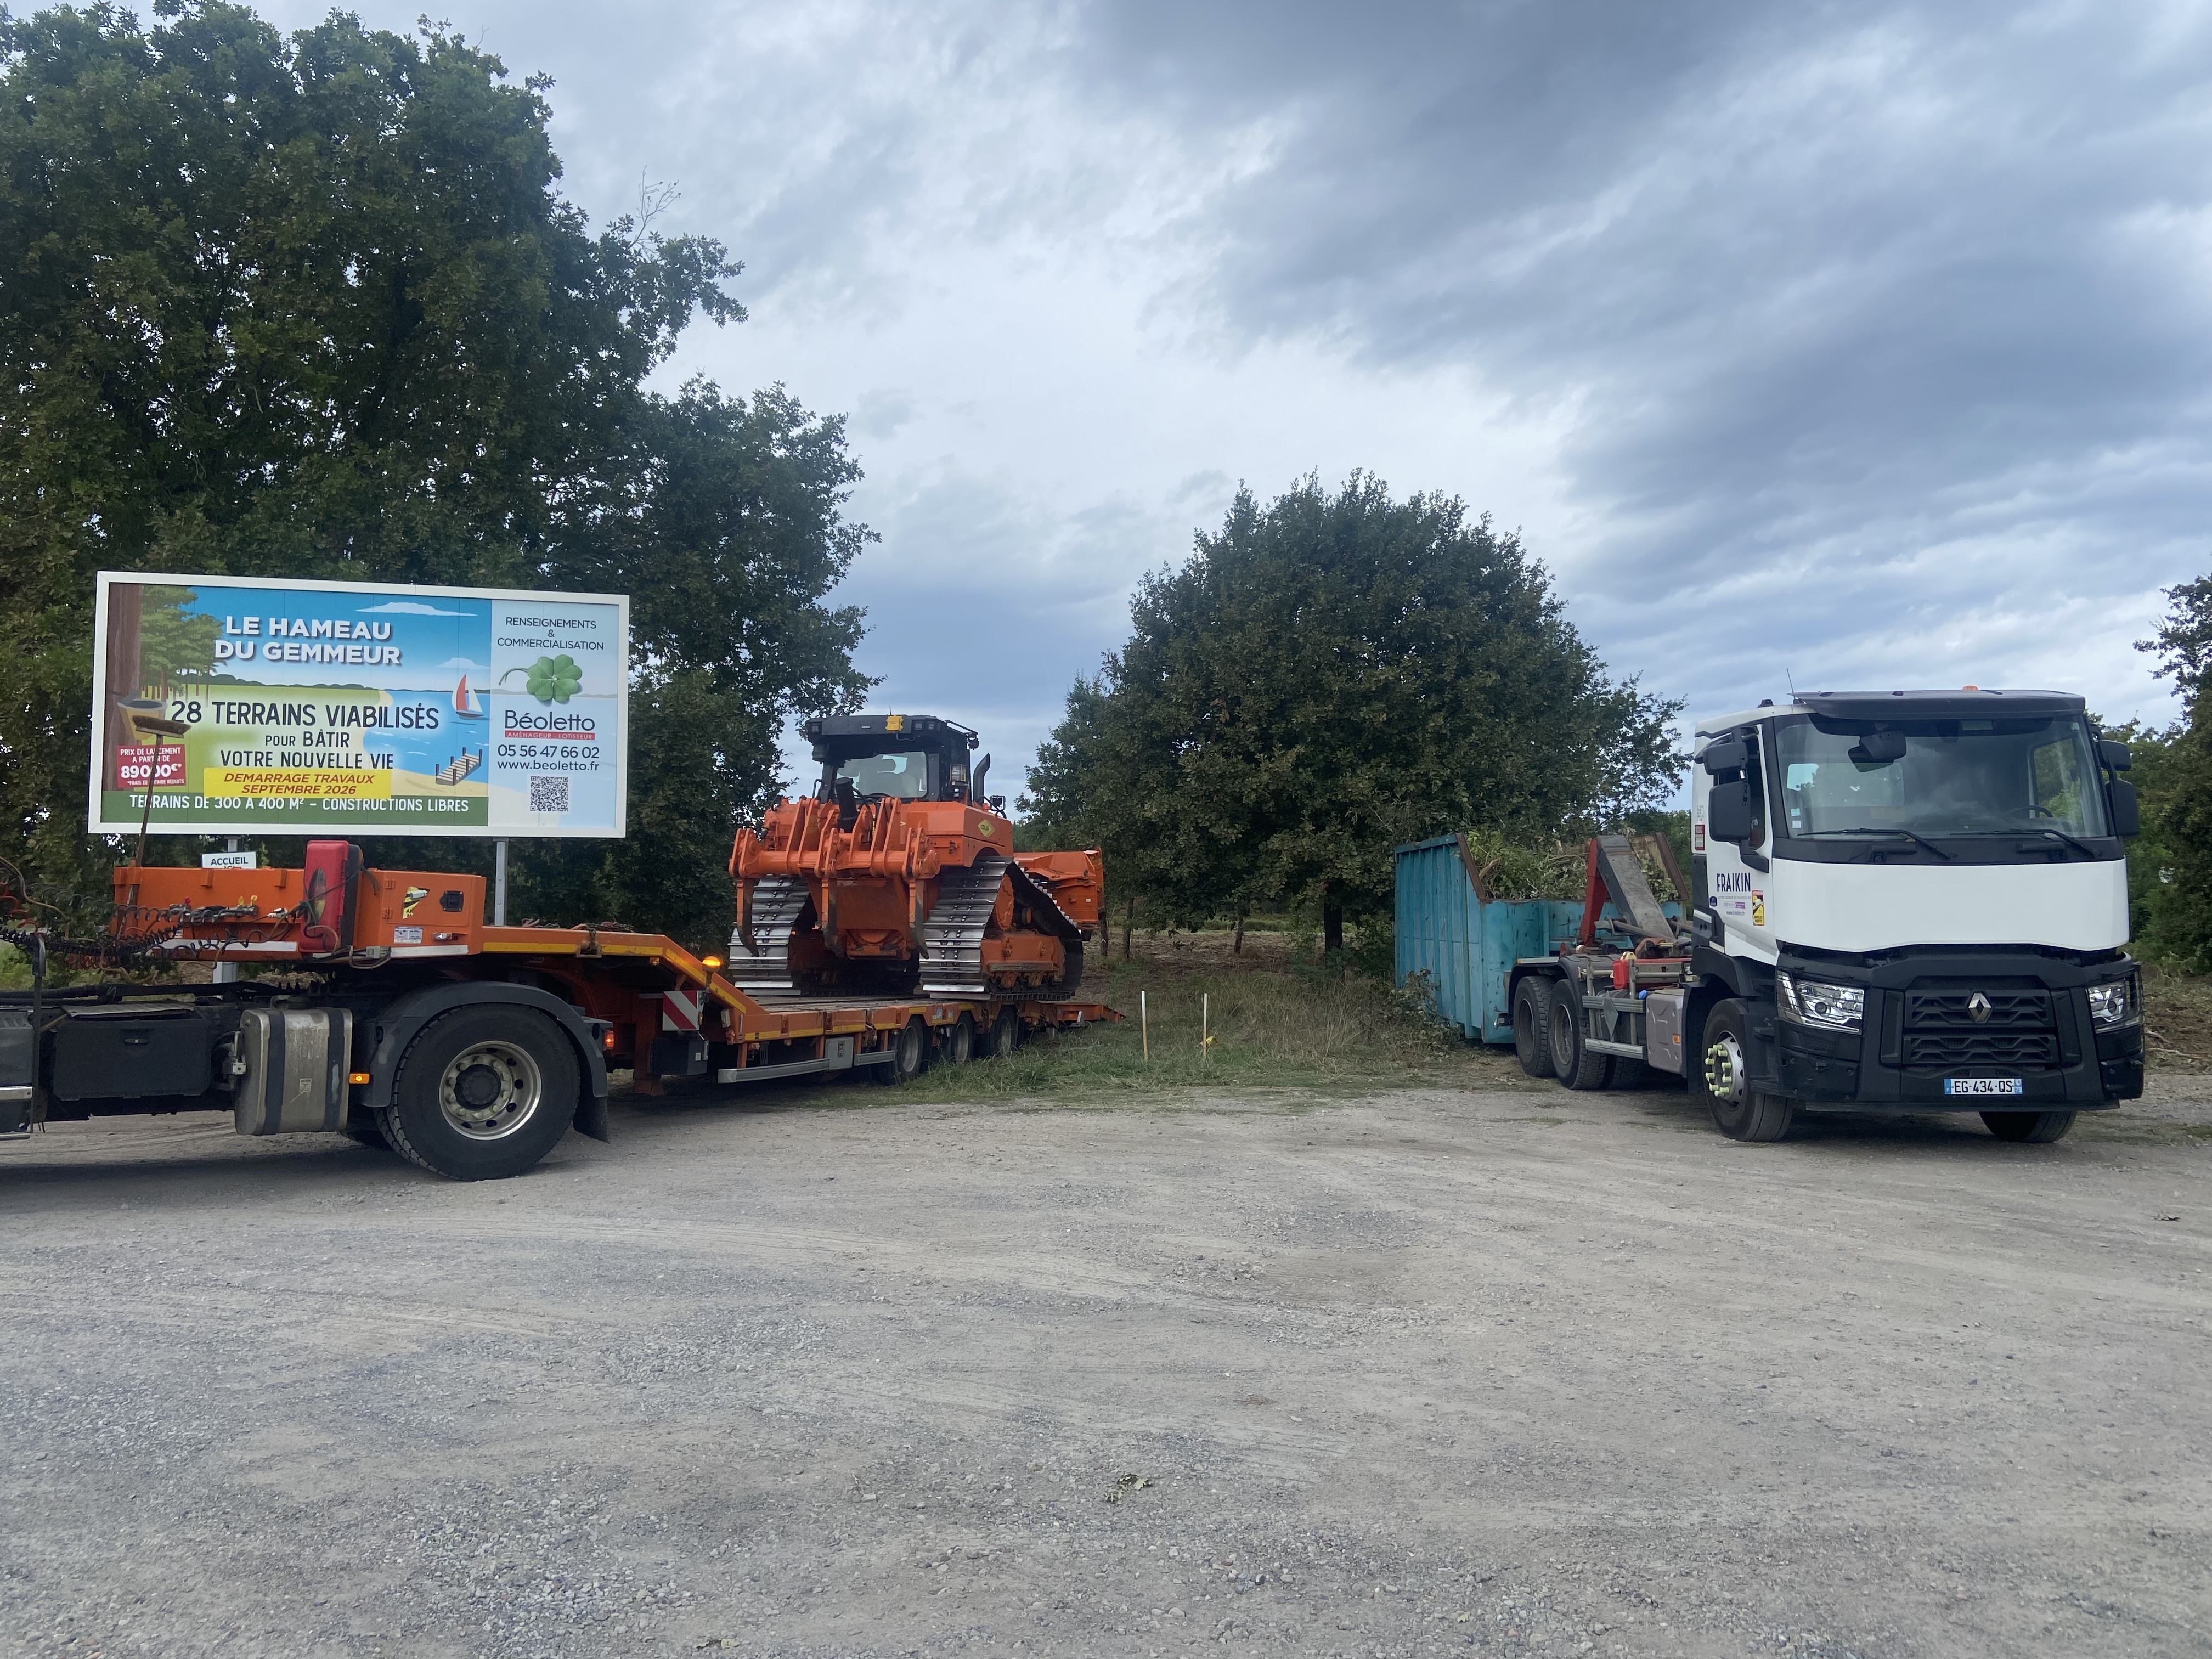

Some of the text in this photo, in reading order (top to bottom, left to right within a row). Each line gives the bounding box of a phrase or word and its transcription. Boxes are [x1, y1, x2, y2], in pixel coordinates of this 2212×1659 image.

[226, 616, 391, 640] LE HAMEAU
[506, 617, 596, 629] RENSEIGNEMENTS
[548, 629, 555, 637] &
[497, 638, 604, 650] COMMERCIALISATION
[215, 640, 400, 664] DU GEMMEUR
[171, 701, 439, 729] 28 TERRAINS VIABILISÉS
[505, 710, 595, 731] Béoletto
[266, 729, 350, 747] POUR BÂTIR
[146, 747, 181, 755] LACEMENT
[498, 744, 600, 759] 05 56 47 66 02
[221, 750, 393, 769] VOTRE NOUVELLE VIE
[498, 759, 600, 771] www.beoletto.fr
[224, 773, 375, 783] DEMARRAGE TRAVAUX
[242, 785, 357, 794] SEPTEMBRE 2026
[195, 796, 210, 809] DE
[215, 797, 241, 809] 300
[245, 797, 254, 809] A
[259, 798, 284, 810] 400
[323, 798, 422, 811] CONSTRUCTIONS
[428, 799, 469, 812] LIBRES
[211, 857, 249, 866] ACCUEIL
[1717, 872, 1751, 893] FRAIKIN
